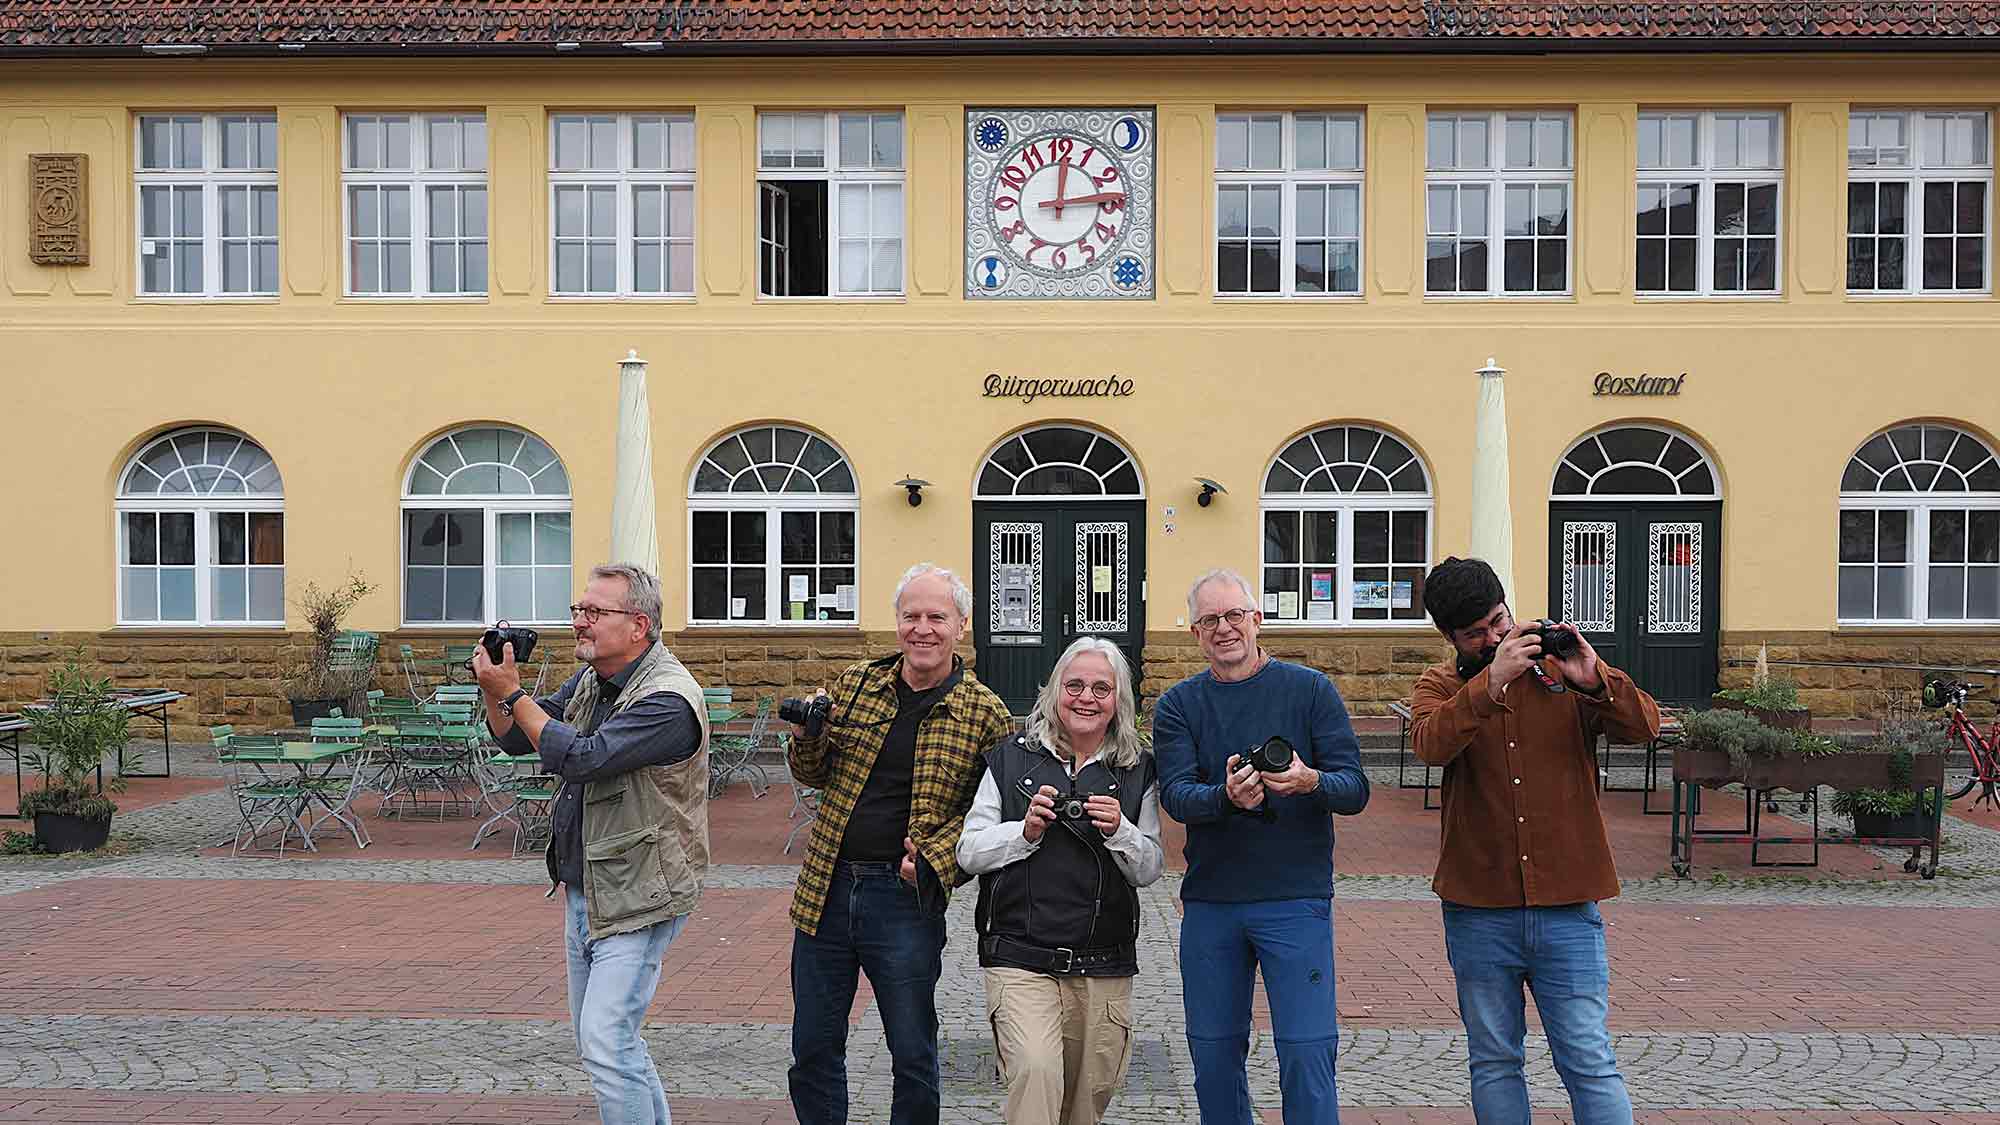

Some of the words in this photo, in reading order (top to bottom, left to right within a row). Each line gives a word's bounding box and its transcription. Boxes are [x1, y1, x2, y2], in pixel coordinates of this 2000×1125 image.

[1022, 144, 1044, 172] 11
[1048, 138, 1073, 163] 12
[1080, 147, 1095, 167] 1
[1000, 165, 1028, 192] 10
[1092, 166, 1119, 187] 2
[1094, 222, 1116, 244] 4
[1078, 238, 1096, 263] 5
[983, 374, 1135, 404] Bürgerwache
[1592, 372, 1687, 396] Postamt
